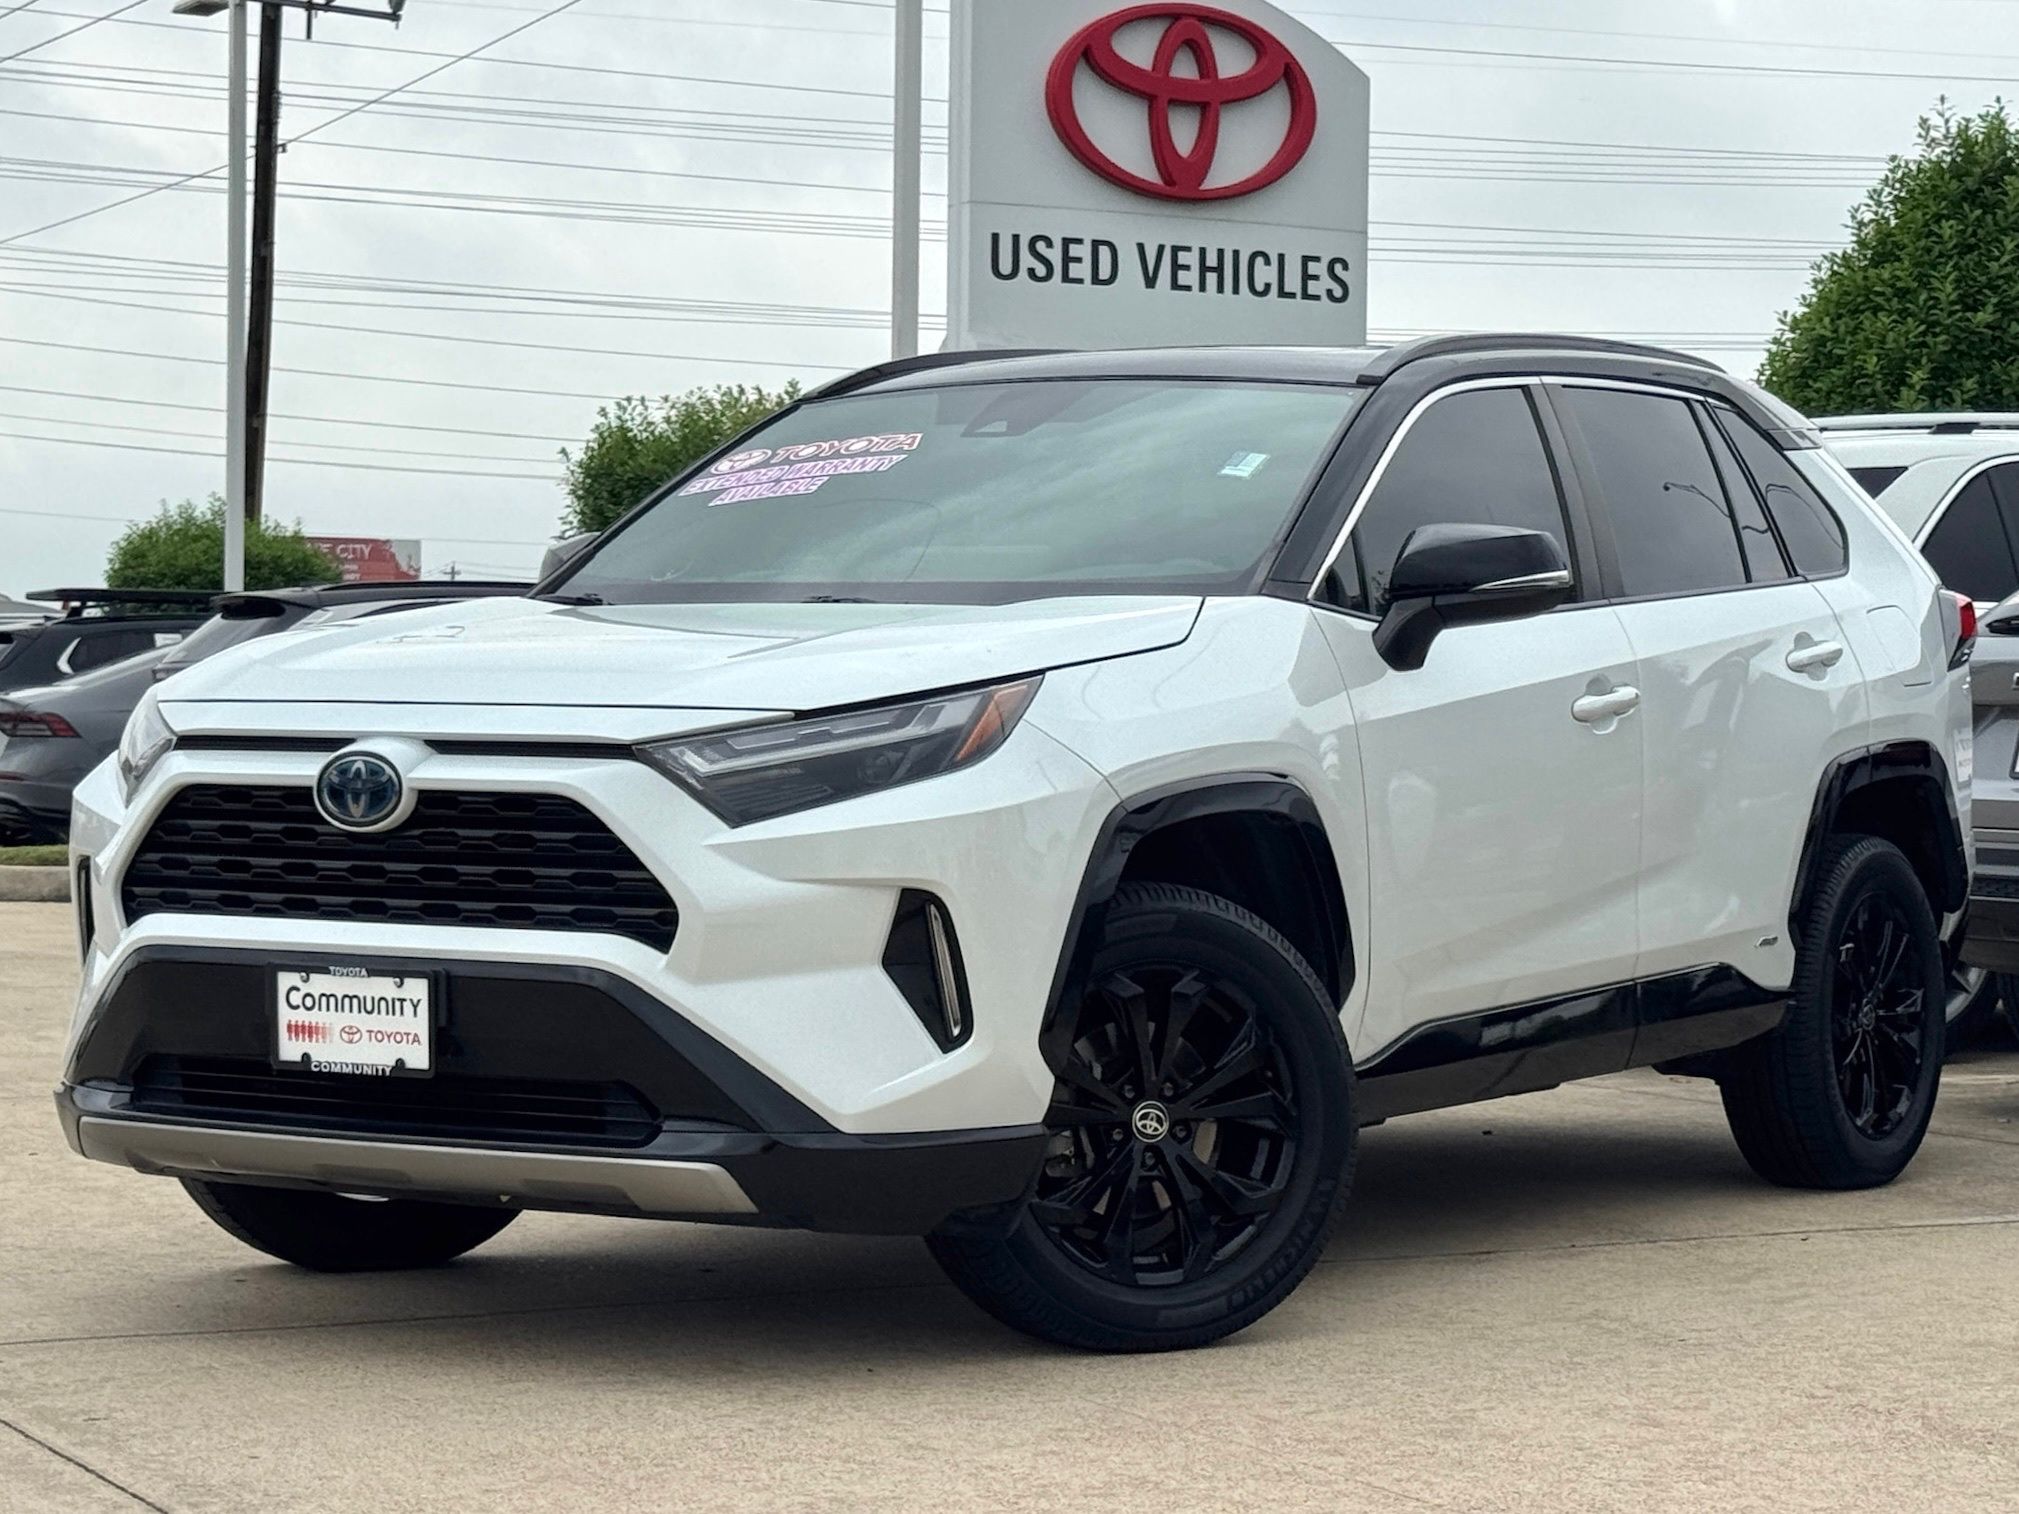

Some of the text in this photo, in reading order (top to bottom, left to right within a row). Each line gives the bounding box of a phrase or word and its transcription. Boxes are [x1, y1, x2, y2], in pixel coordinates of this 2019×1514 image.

[990, 232, 1351, 304] USED VEHICLES
[769, 433, 923, 464] TOYOTA
[786, 455, 904, 479] WARRANTY
[712, 476, 828, 505] AVAILABLE
[336, 543, 373, 560] CITY
[329, 966, 368, 978] TOYOTA
[366, 1029, 421, 1046] TOYOTA
[310, 1061, 393, 1076] COMMUNITY
